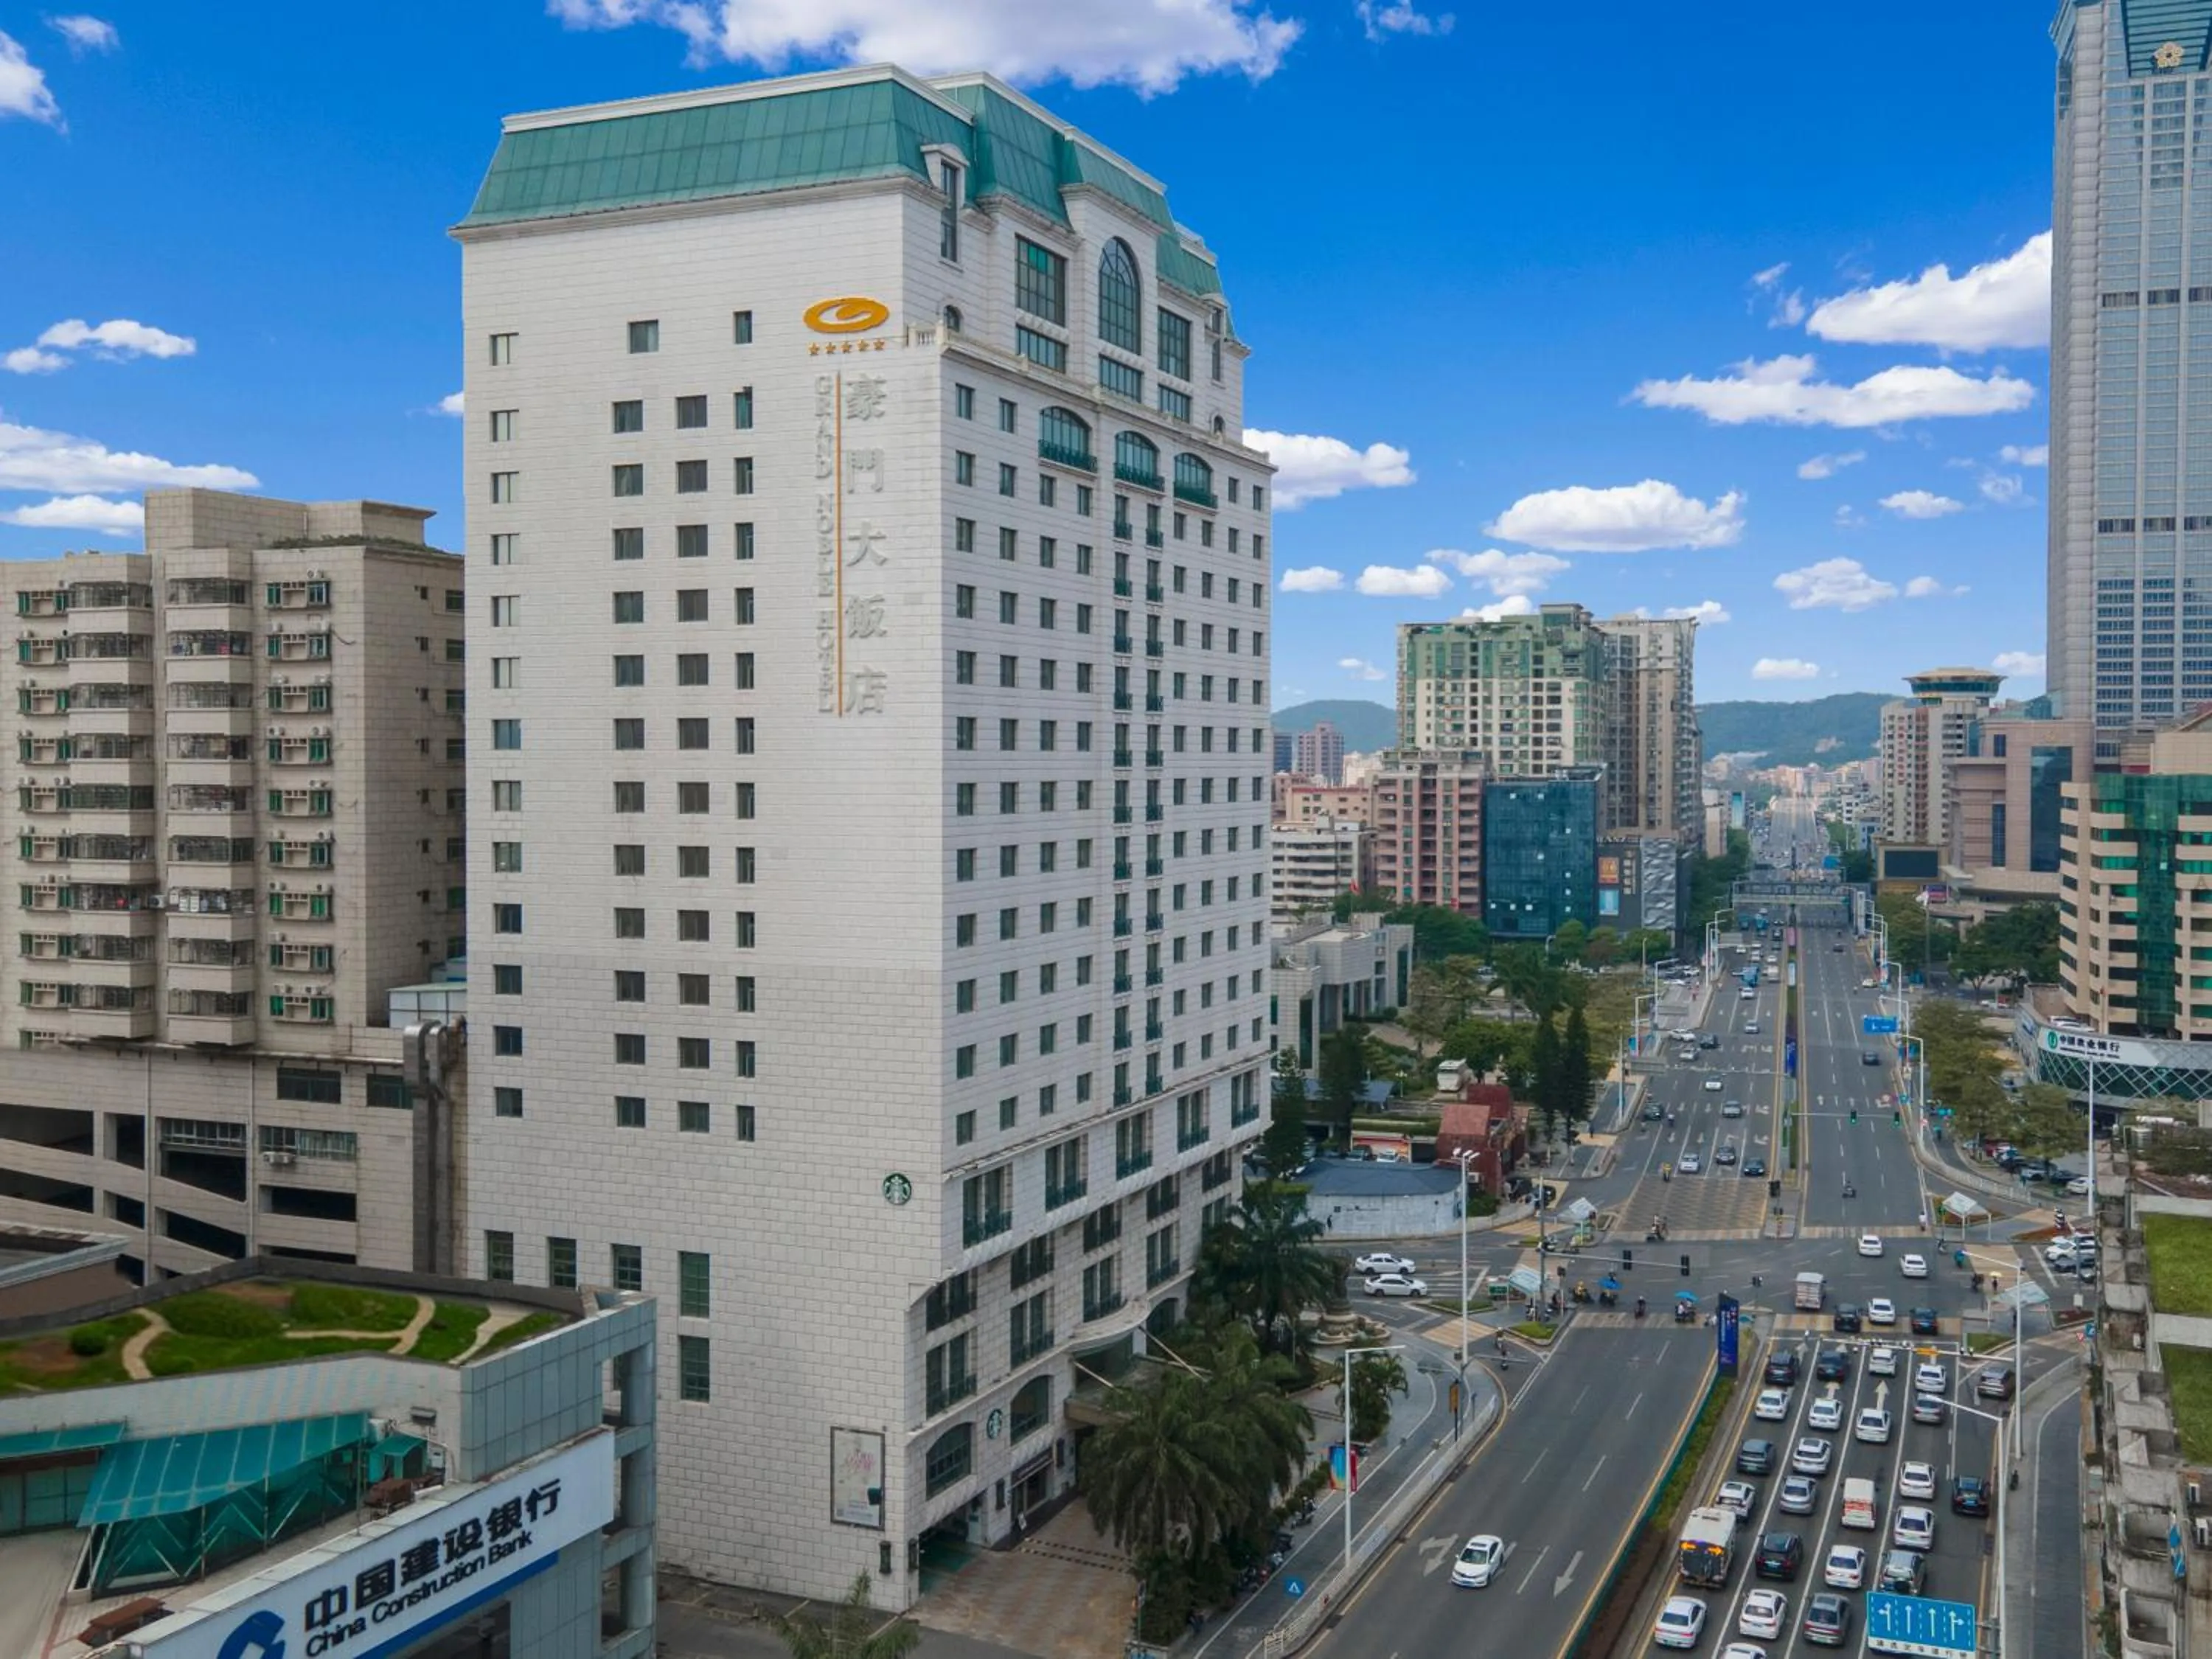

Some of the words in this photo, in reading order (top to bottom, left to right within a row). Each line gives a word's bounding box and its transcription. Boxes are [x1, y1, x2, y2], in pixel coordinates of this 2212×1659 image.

[845, 374, 887, 715] 豪門大飯店
[305, 1478, 561, 1632] 中国建设银行
[305, 1617, 366, 1658] China
[372, 1554, 485, 1623] Construction
[488, 1530, 532, 1565] Bank
